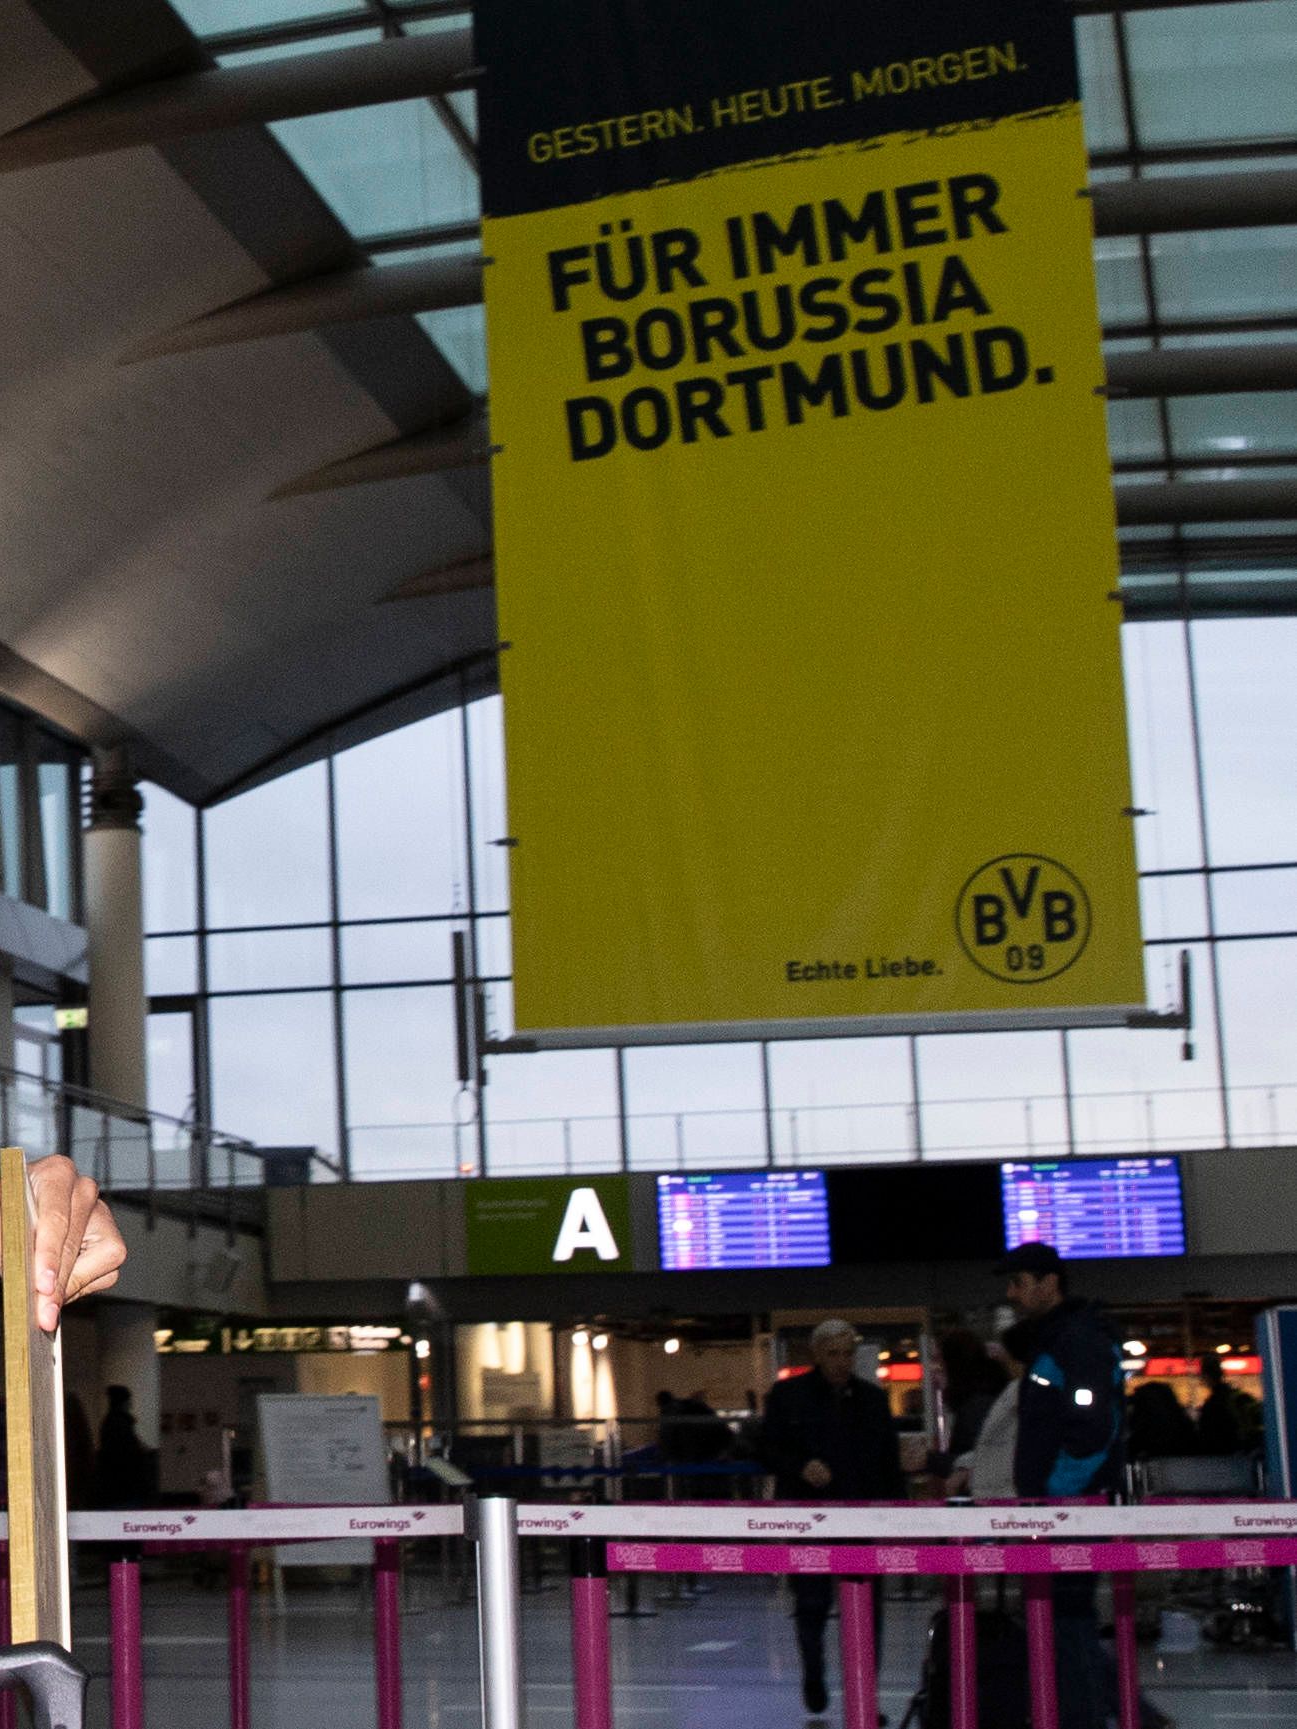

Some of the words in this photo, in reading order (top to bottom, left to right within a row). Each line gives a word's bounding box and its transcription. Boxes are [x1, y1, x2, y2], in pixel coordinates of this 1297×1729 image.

[526, 103, 705, 165] GESTERN.
[710, 77, 846, 128] HEUTE.
[852, 42, 1028, 101] MORGEN.
[546, 218, 709, 314] FÜR
[724, 173, 1009, 281] IMMER
[579, 254, 993, 384] BORUSSIA
[563, 324, 1056, 463] DORTMUND.
[972, 865, 1079, 946] BVB
[785, 959, 857, 982] Echte
[865, 956, 943, 980] Liebe.
[1005, 944, 1046, 972] 09
[552, 1187, 620, 1262] A
[123, 1521, 182, 1535] Eurowings
[349, 1518, 411, 1531] Eurowings
[747, 1518, 812, 1532] Eurowings
[990, 1517, 1055, 1532] Eurowings
